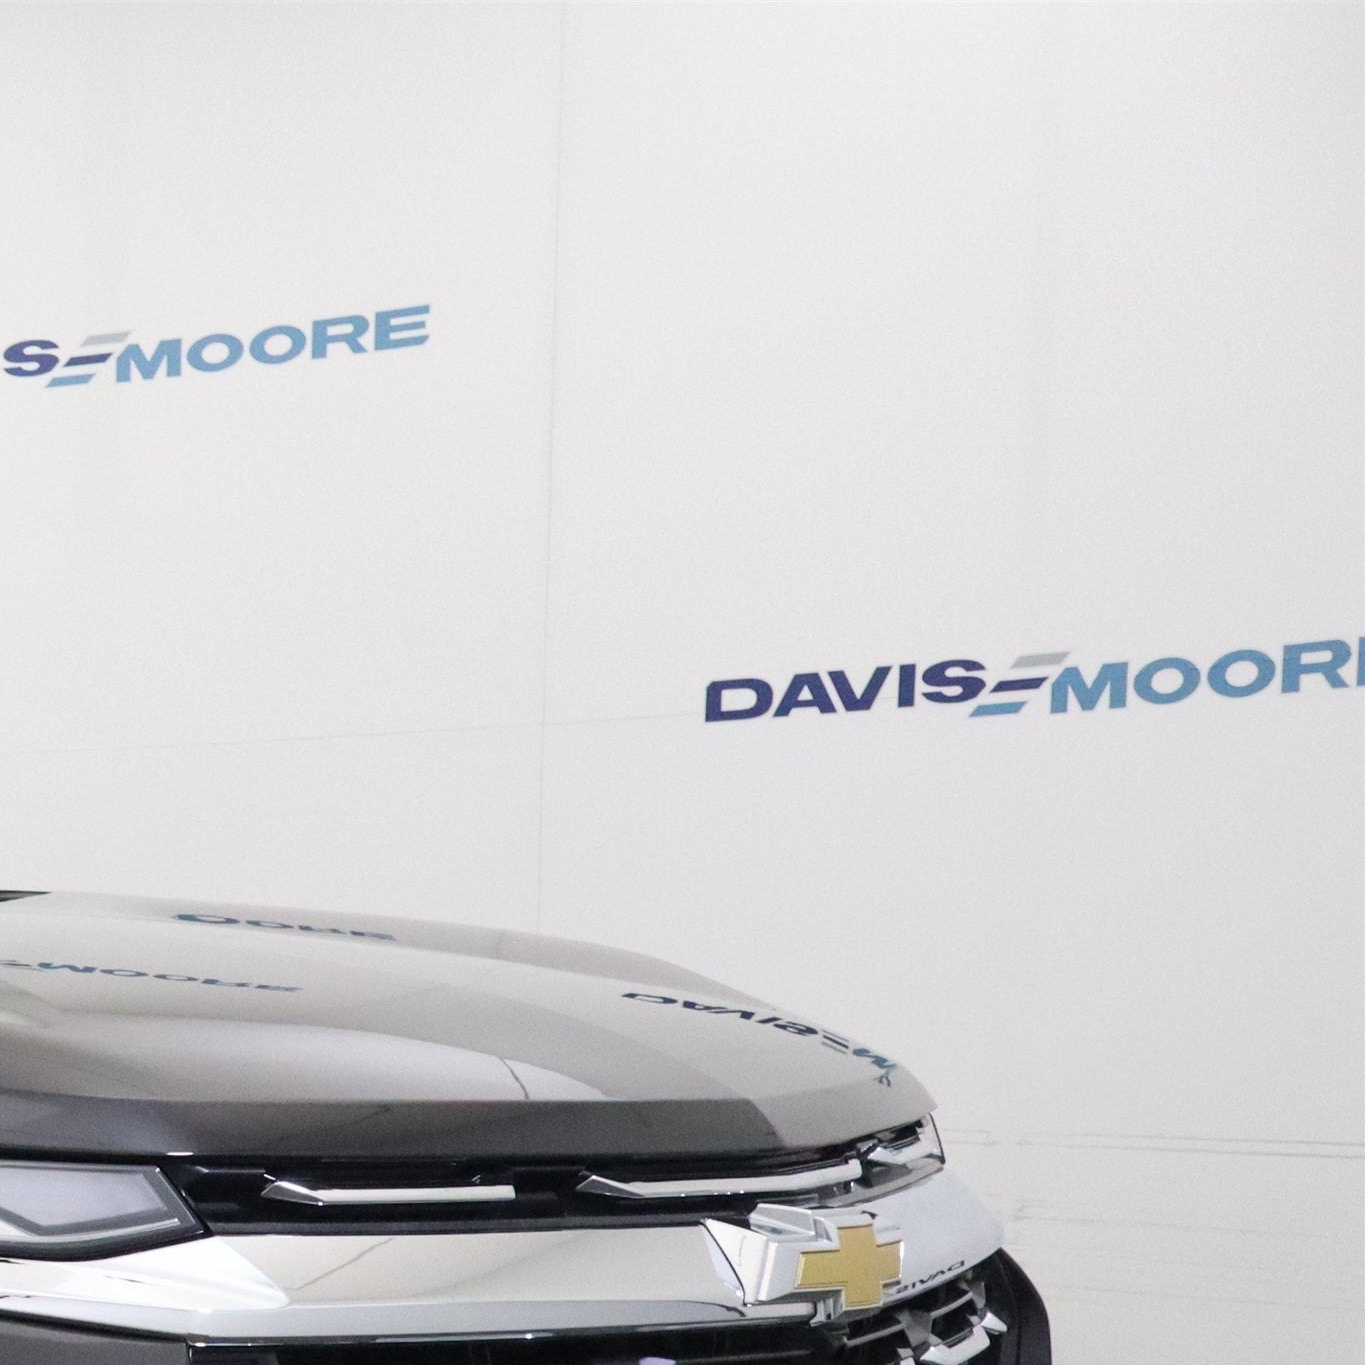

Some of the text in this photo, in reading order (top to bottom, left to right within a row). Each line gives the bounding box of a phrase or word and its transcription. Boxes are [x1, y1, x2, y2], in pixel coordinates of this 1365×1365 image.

[115, 304, 431, 384] MOORE
[704, 636, 1365, 724] DAVIS MOOR
